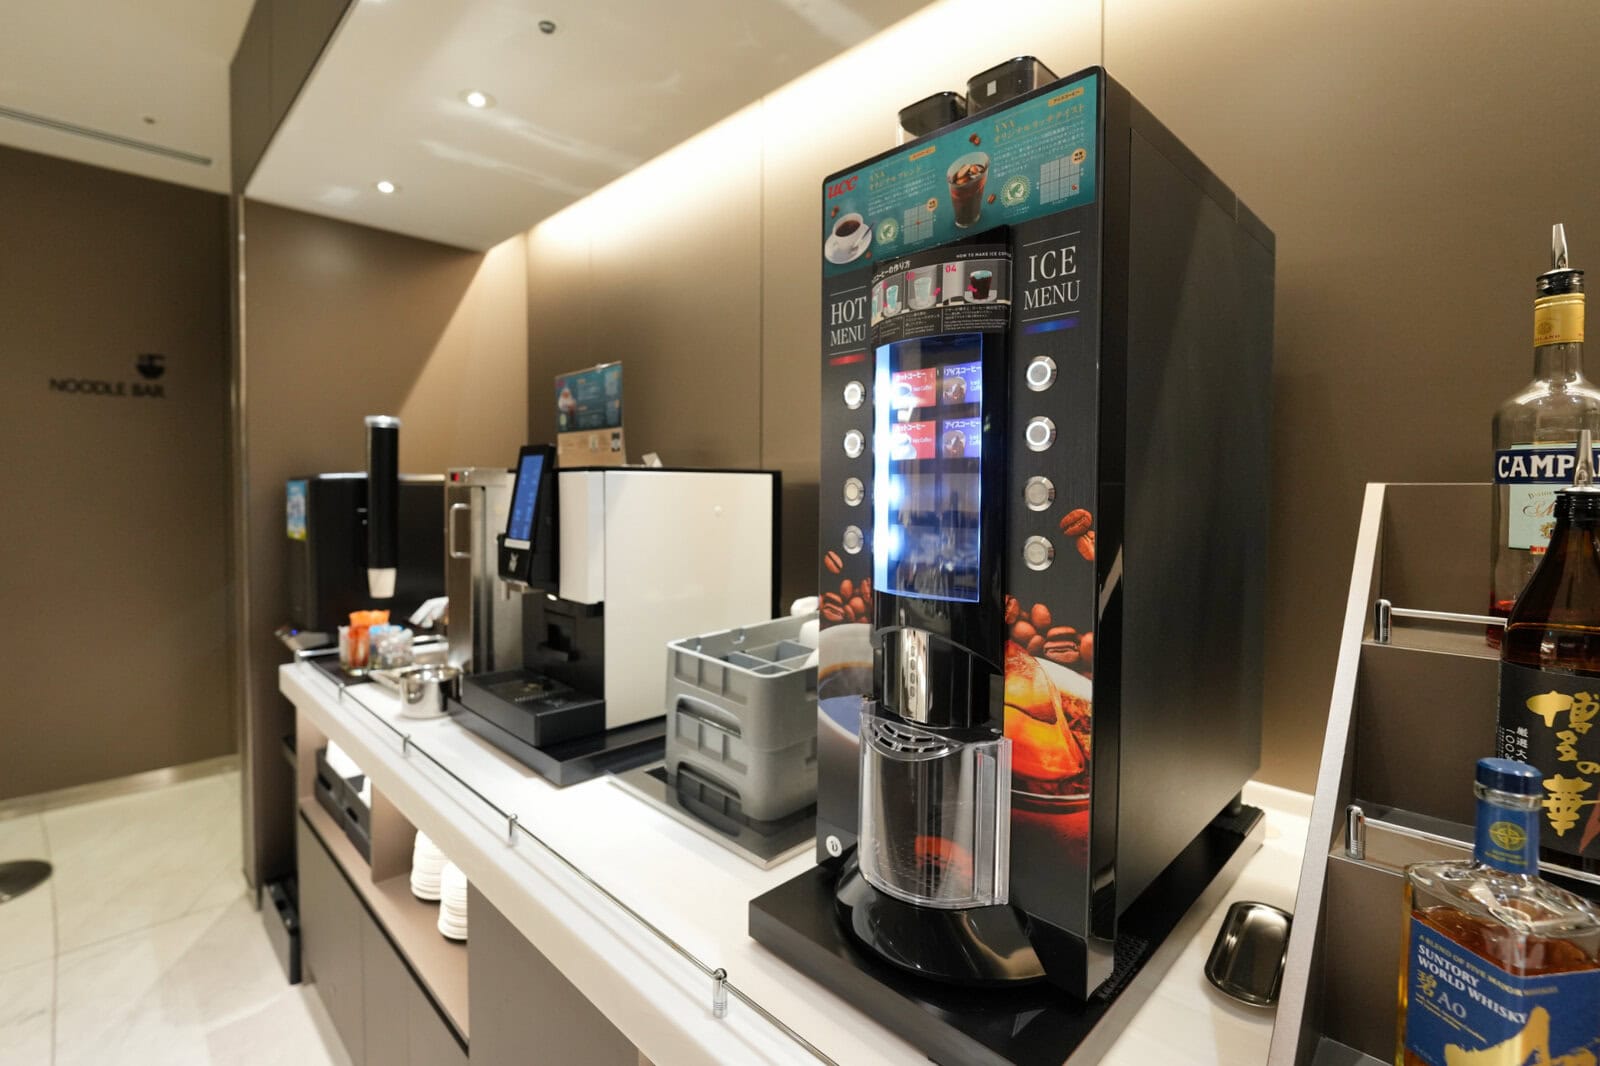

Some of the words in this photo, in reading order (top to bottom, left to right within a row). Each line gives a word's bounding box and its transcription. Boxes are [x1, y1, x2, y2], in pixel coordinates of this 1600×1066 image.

[945, 264, 957, 273] 04
[1028, 246, 1077, 284] ICE
[1024, 280, 1081, 311] MENU
[831, 296, 867, 325] HOT
[831, 324, 867, 347] MENU
[49, 379, 125, 397] NOODLE
[131, 382, 165, 398] BAR
[1498, 454, 1600, 478] CAMP
[1516, 726, 1529, 763] 厳選大
[1418, 944, 1481, 987] SUNTORY
[1417, 954, 1466, 991] WORLD
[1468, 986, 1528, 1024] WHISKY
[1437, 991, 1467, 1019] AO
